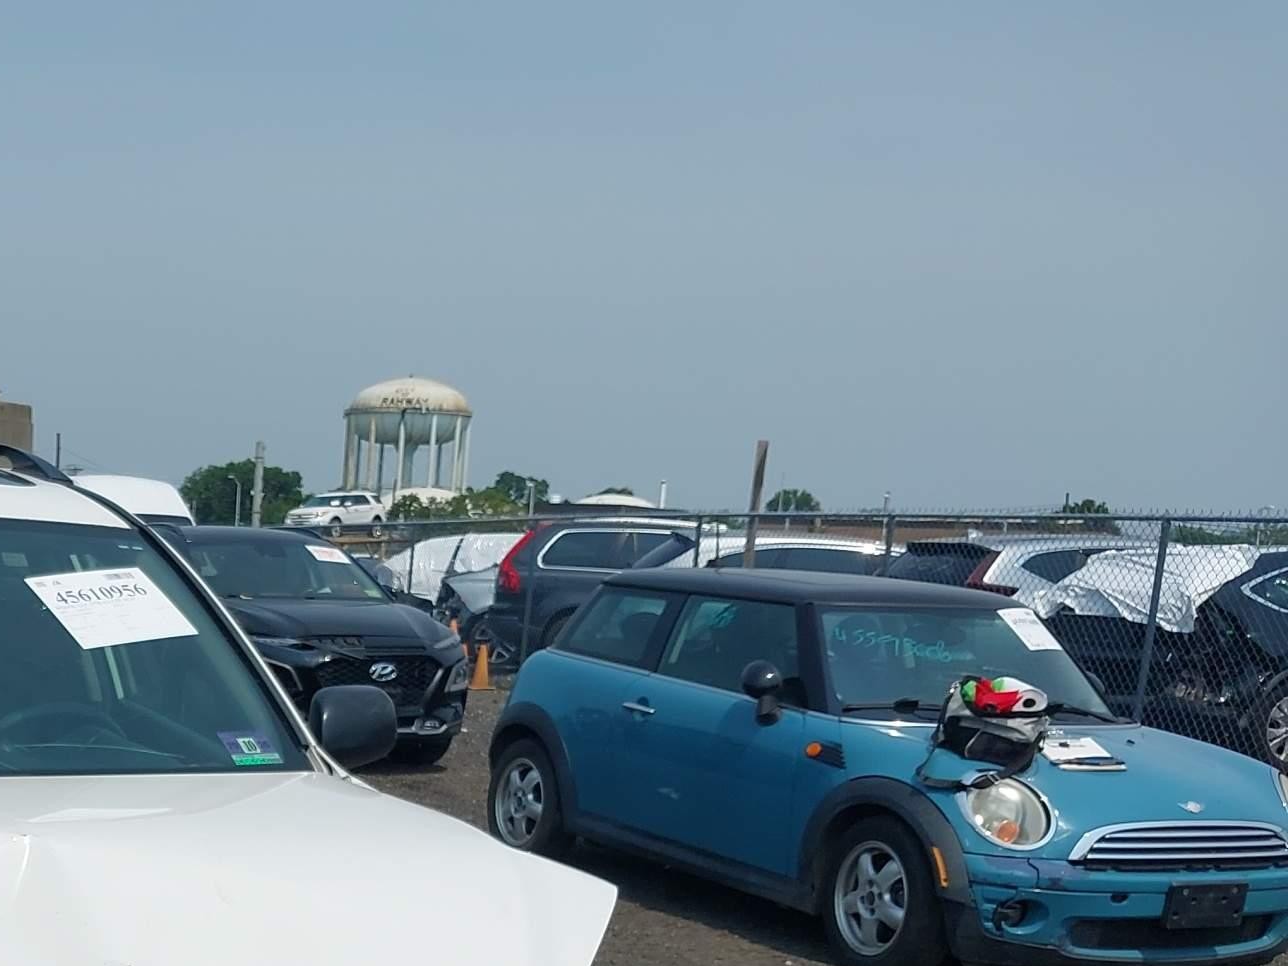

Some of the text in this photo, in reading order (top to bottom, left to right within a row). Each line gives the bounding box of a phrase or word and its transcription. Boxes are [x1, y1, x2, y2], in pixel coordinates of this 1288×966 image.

[380, 396, 430, 406] RAHWAY
[55, 582, 148, 605] 45610956
[242, 739, 258, 752] 10
